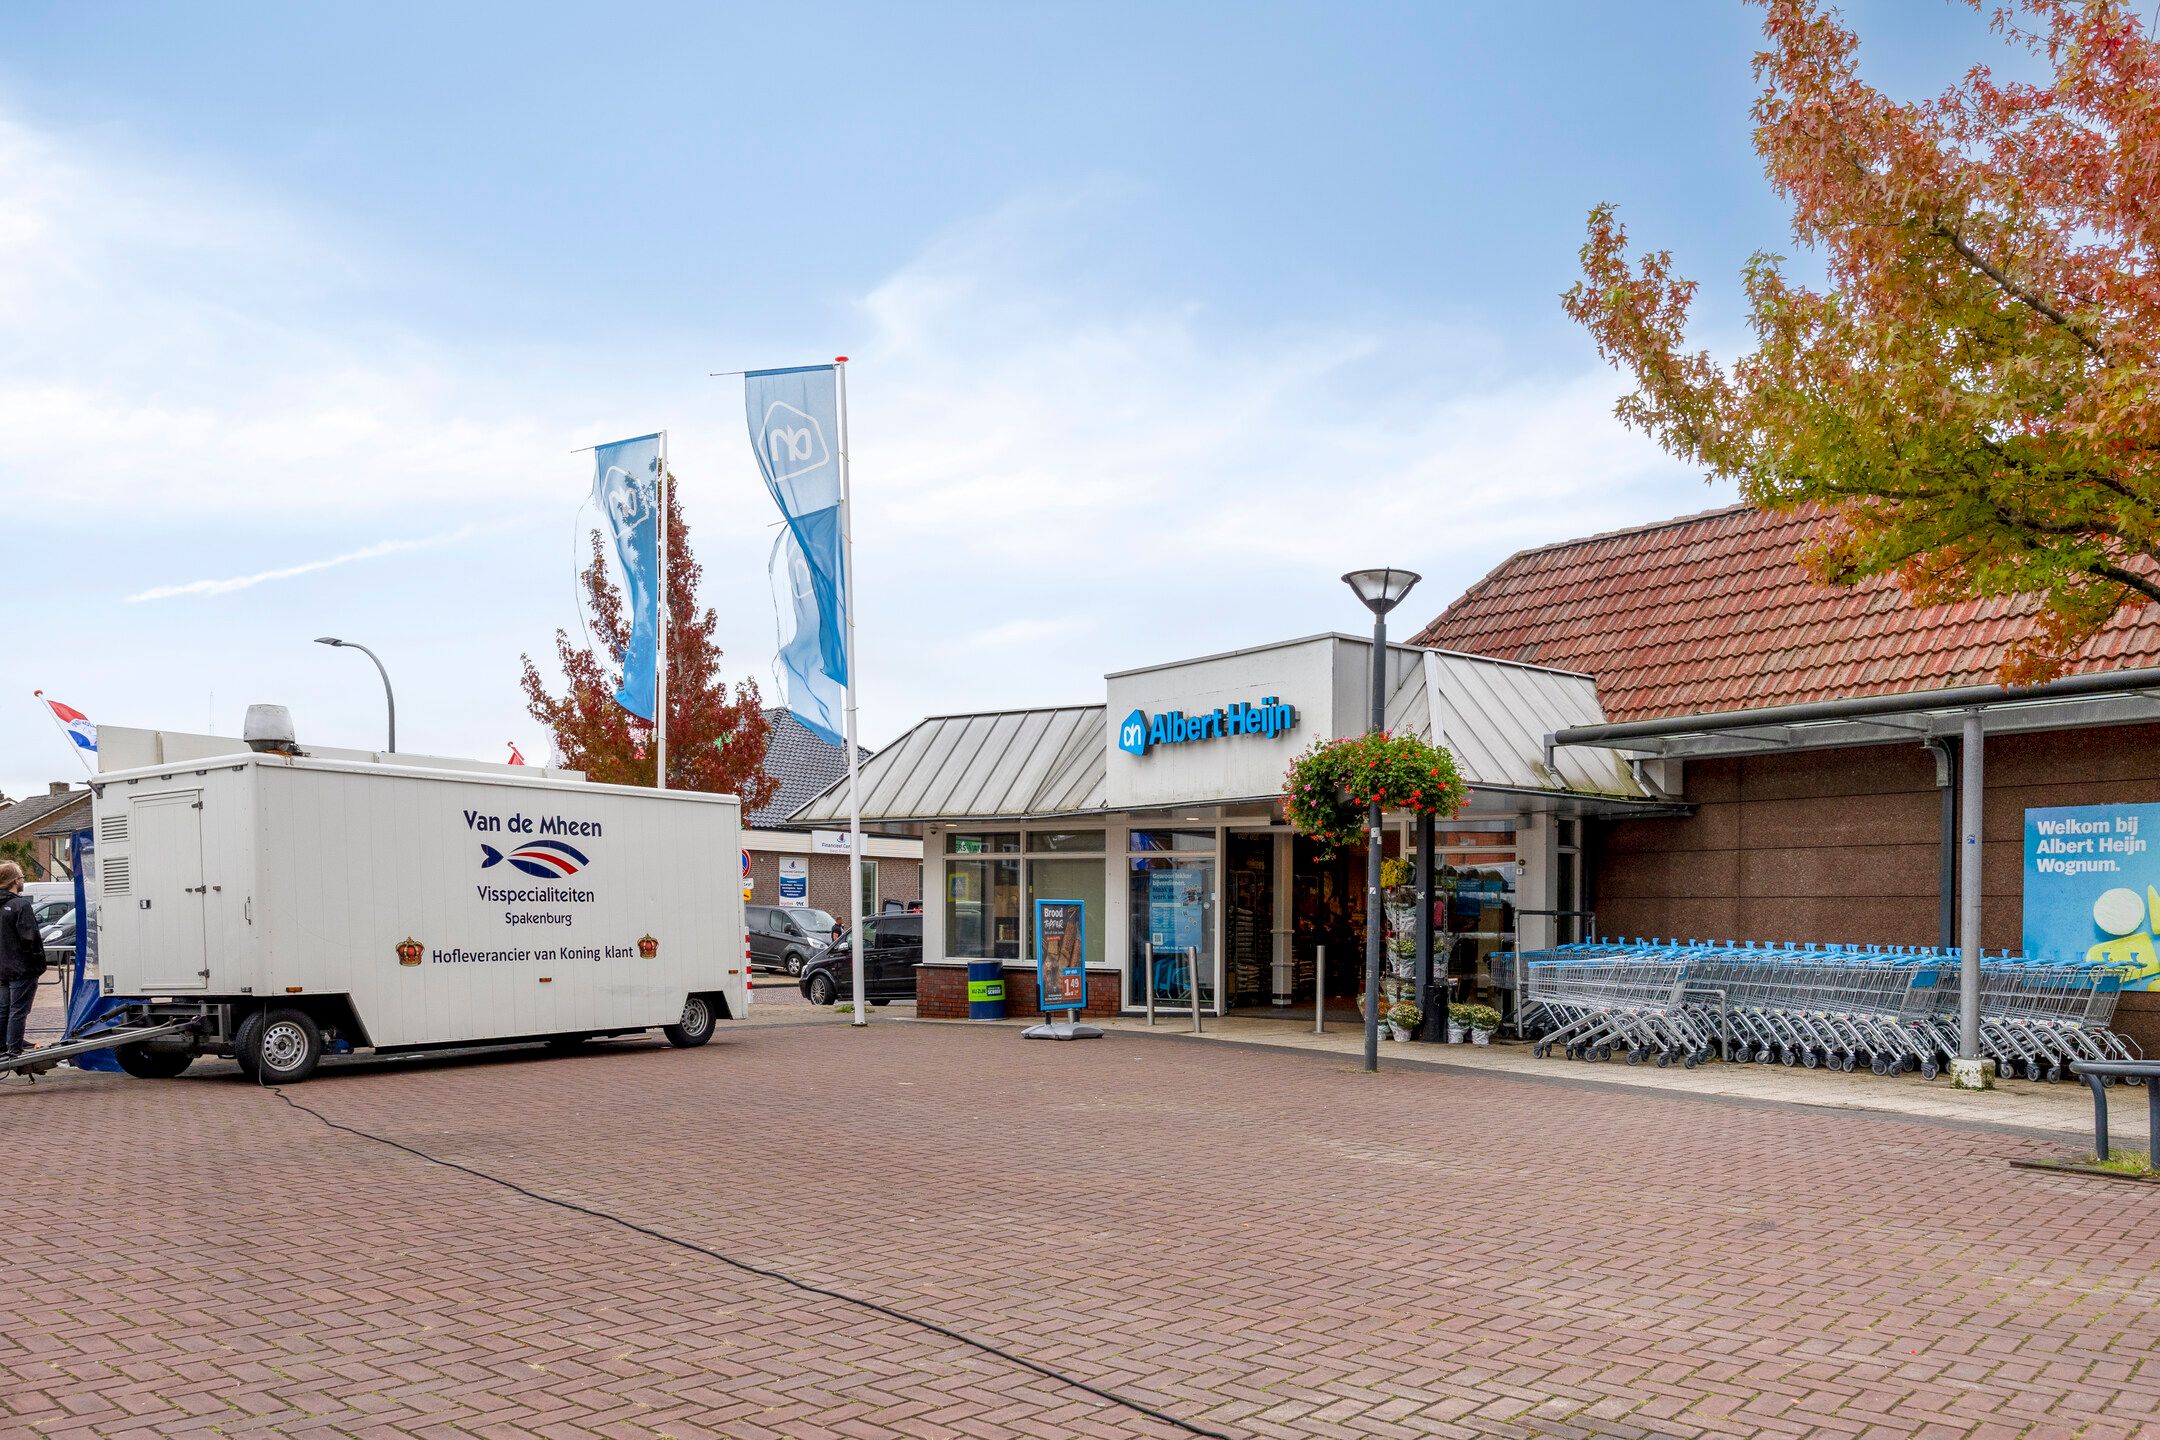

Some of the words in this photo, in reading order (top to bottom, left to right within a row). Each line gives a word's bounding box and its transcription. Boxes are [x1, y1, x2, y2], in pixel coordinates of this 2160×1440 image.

[1149, 708, 1224, 746] Albert
[1228, 696, 1293, 740] Heijn
[463, 810, 501, 832] Van
[507, 813, 533, 834] de
[539, 815, 602, 837] Mheen
[2037, 818, 2110, 835] Welkom
[2115, 816, 2138, 836] bij
[2036, 838, 2094, 854] Albert
[2099, 836, 2147, 855] Heijn
[2036, 858, 2121, 876] Wognum.
[477, 885, 595, 905] Visspecialiteiten
[505, 912, 573, 927] Spakenburg
[1044, 907, 1064, 918] Brood
[432, 948, 531, 964] Hofleverancier
[534, 950, 557, 961] van
[560, 946, 601, 962] Koning
[605, 945, 634, 959] klant
